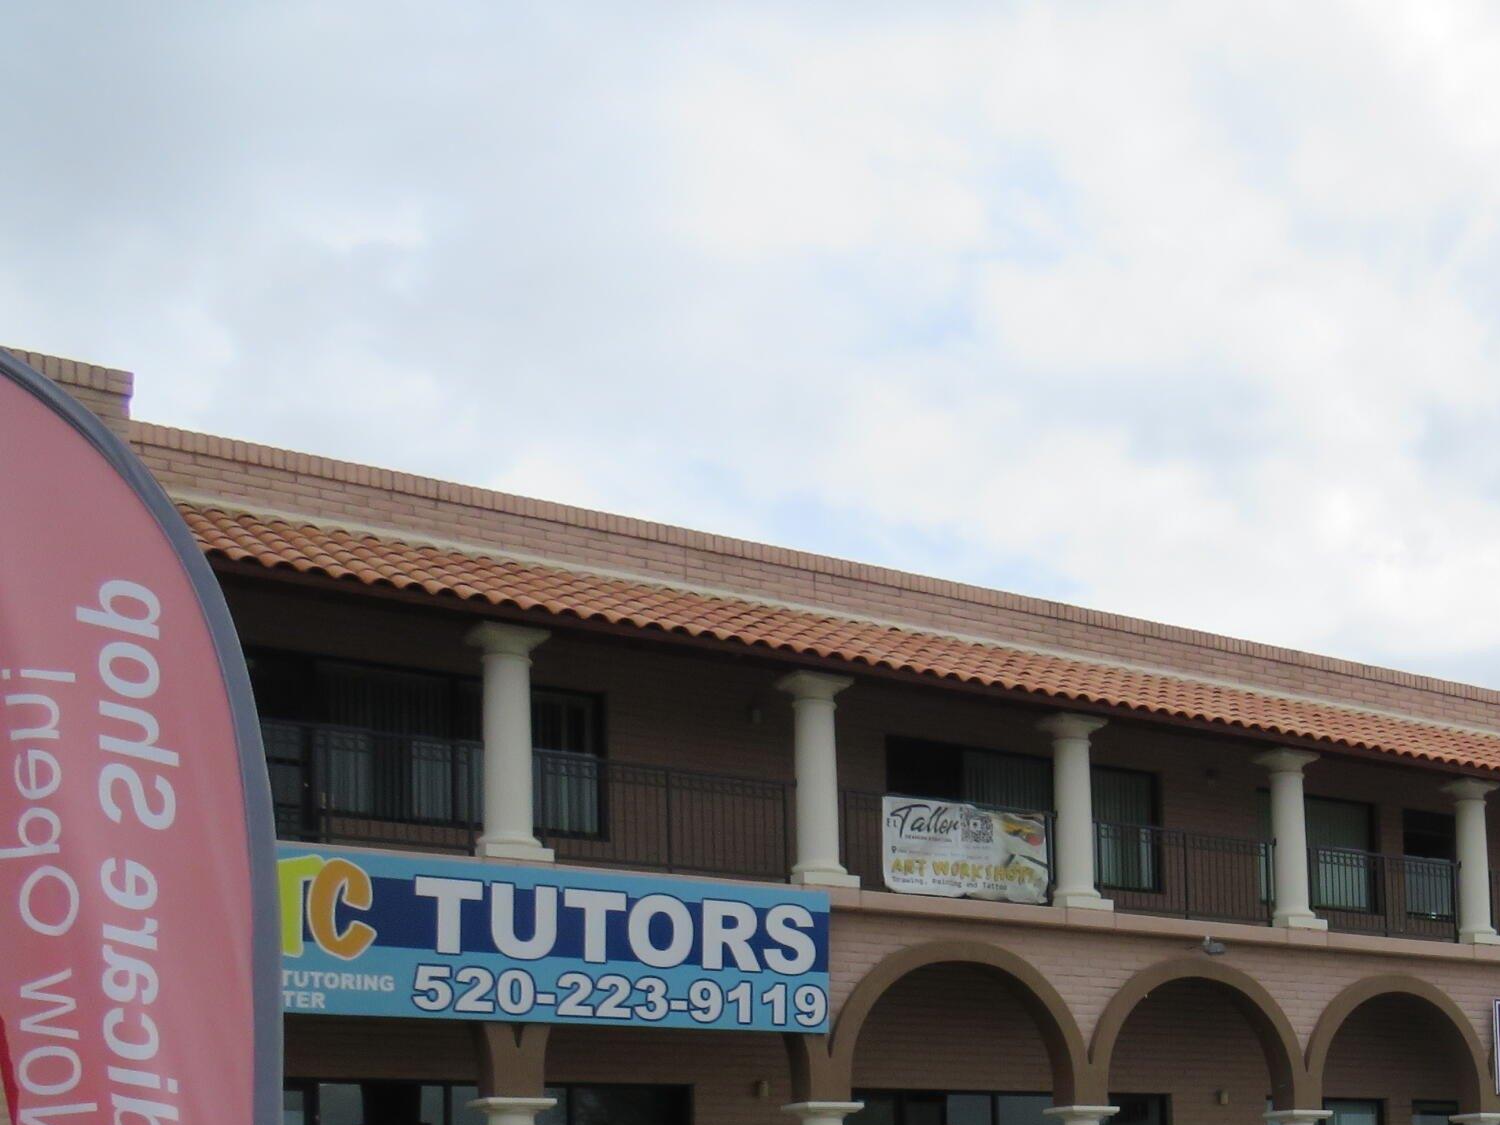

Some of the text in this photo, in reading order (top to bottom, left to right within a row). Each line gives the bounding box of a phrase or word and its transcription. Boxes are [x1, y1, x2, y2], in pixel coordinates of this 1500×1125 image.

[890, 803, 959, 838] Taller
[891, 857, 927, 877] ART
[413, 875, 817, 975] TUTORS
[282, 969, 396, 992] TUTORING
[411, 963, 828, 1027] 520-223-9119
